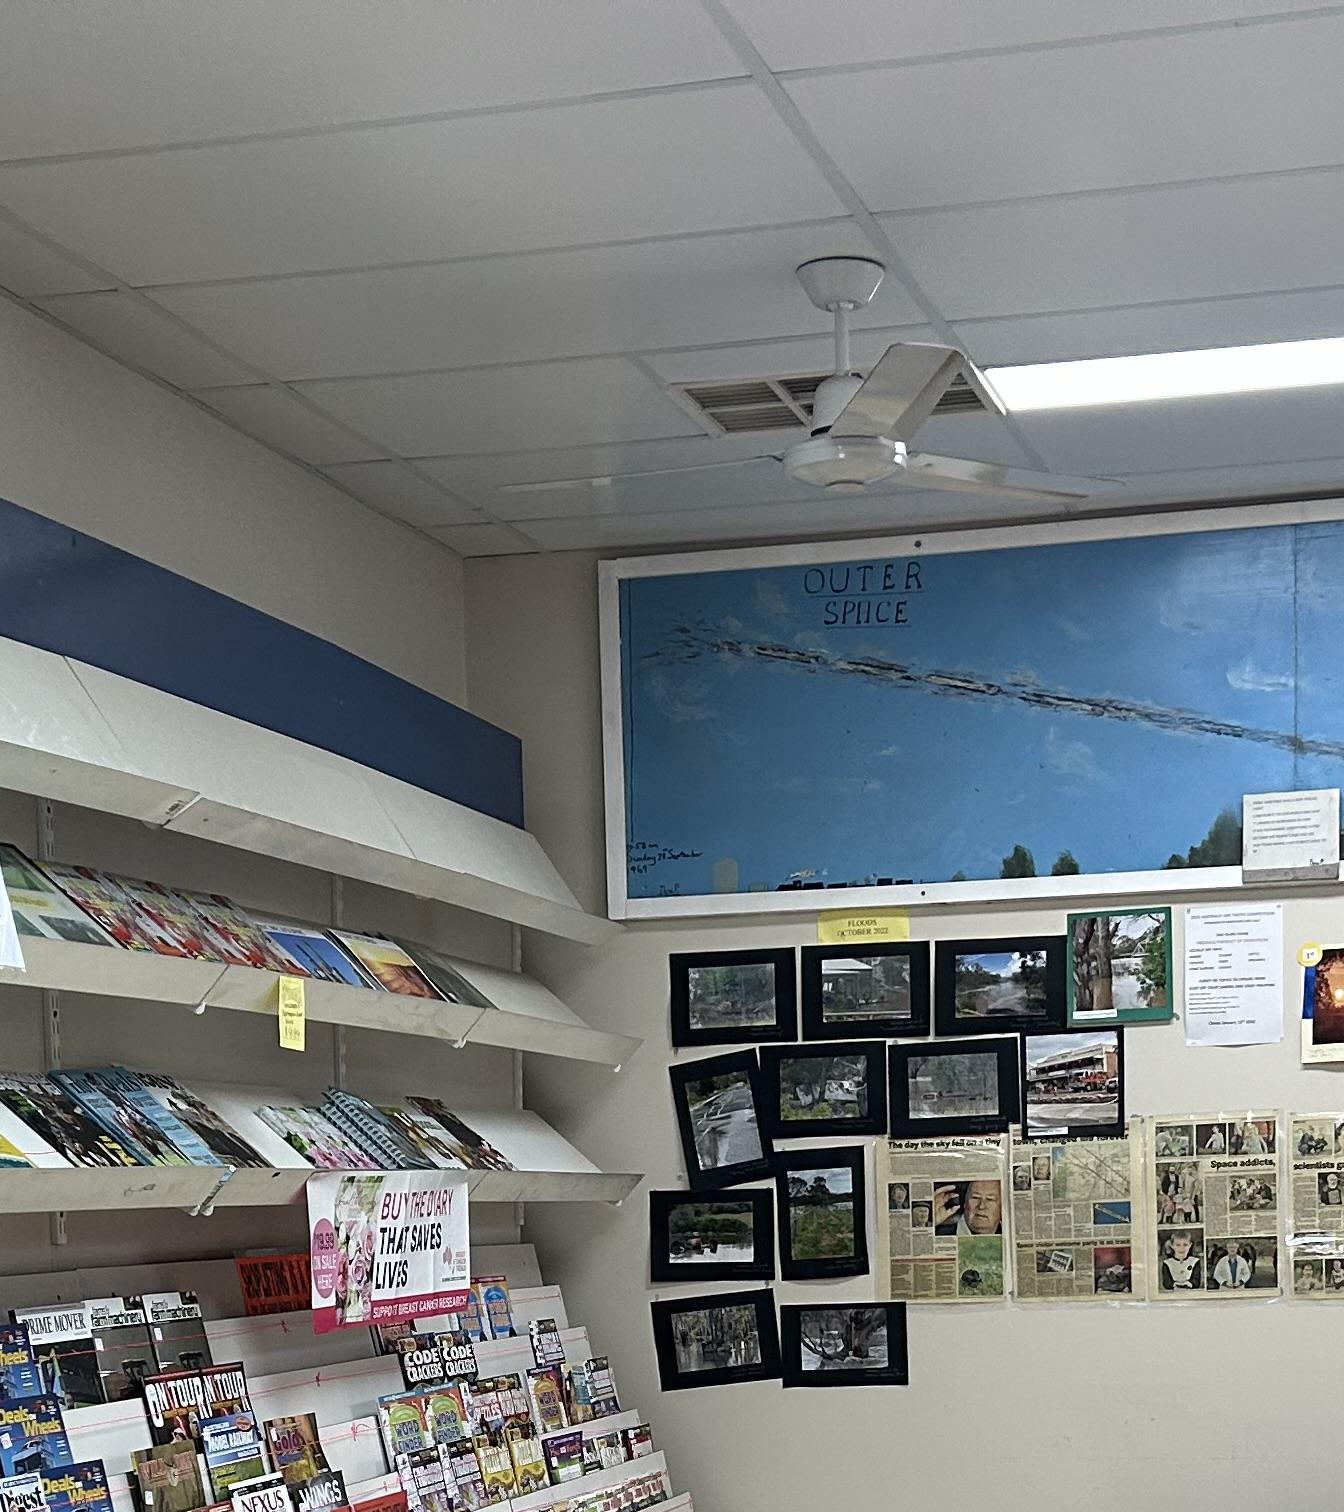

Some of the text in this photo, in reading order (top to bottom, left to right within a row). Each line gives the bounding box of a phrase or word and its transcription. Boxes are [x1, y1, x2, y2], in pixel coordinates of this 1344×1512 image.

[804, 562, 922, 594] OUTER
[837, 928, 872, 938] OCTOBER
[848, 919, 877, 928] FLOODS
[904, 1142, 918, 1150] day
[921, 1141, 934, 1149] the
[936, 1140, 950, 1150] sky
[1210, 1160, 1237, 1170] Space
[409, 1191, 426, 1219] THE
[426, 1189, 454, 1217] DIARY
[379, 1223, 442, 1255] THAT SAVES
[374, 1259, 409, 1291] LIVES
[439, 1295, 467, 1309] RESEARCH
[23, 1312, 87, 1336] PRIME MOVER
[404, 1348, 440, 1367] CODE
[406, 1362, 443, 1382] CRACKERS
